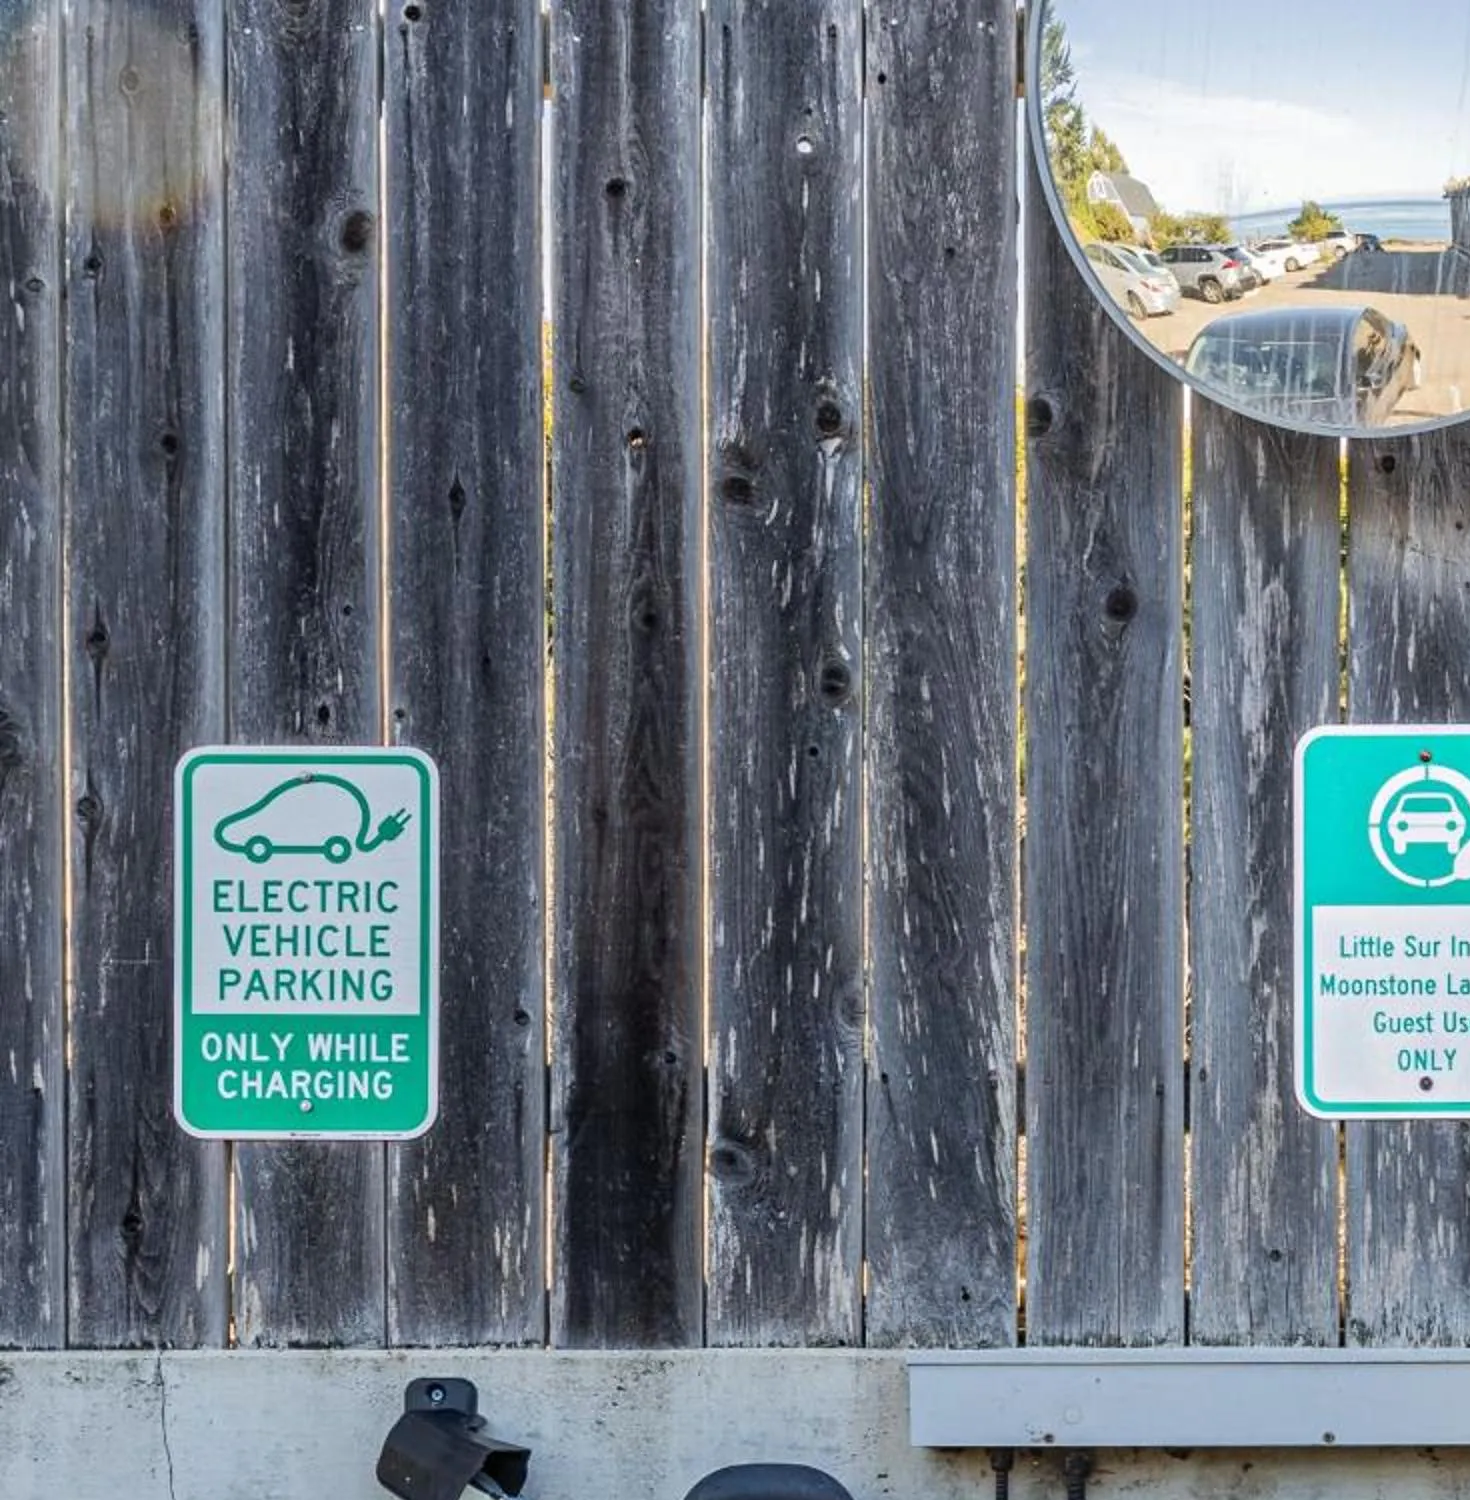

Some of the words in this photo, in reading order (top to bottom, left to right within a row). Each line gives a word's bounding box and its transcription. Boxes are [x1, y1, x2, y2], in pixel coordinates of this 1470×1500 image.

[213, 880, 399, 913] ELECTRIC
[223, 924, 391, 958] VEHICLE
[1339, 935, 1395, 958] Little
[1404, 935, 1440, 958] Sur
[219, 969, 393, 1001] PARKING
[1320, 973, 1437, 996] Moonstone
[1373, 1011, 1434, 1034] Guest
[200, 1032, 294, 1062] ONLY
[307, 1032, 411, 1063] WHILE
[1397, 1049, 1457, 1072] ONLY
[217, 1069, 394, 1100] CHARGING
